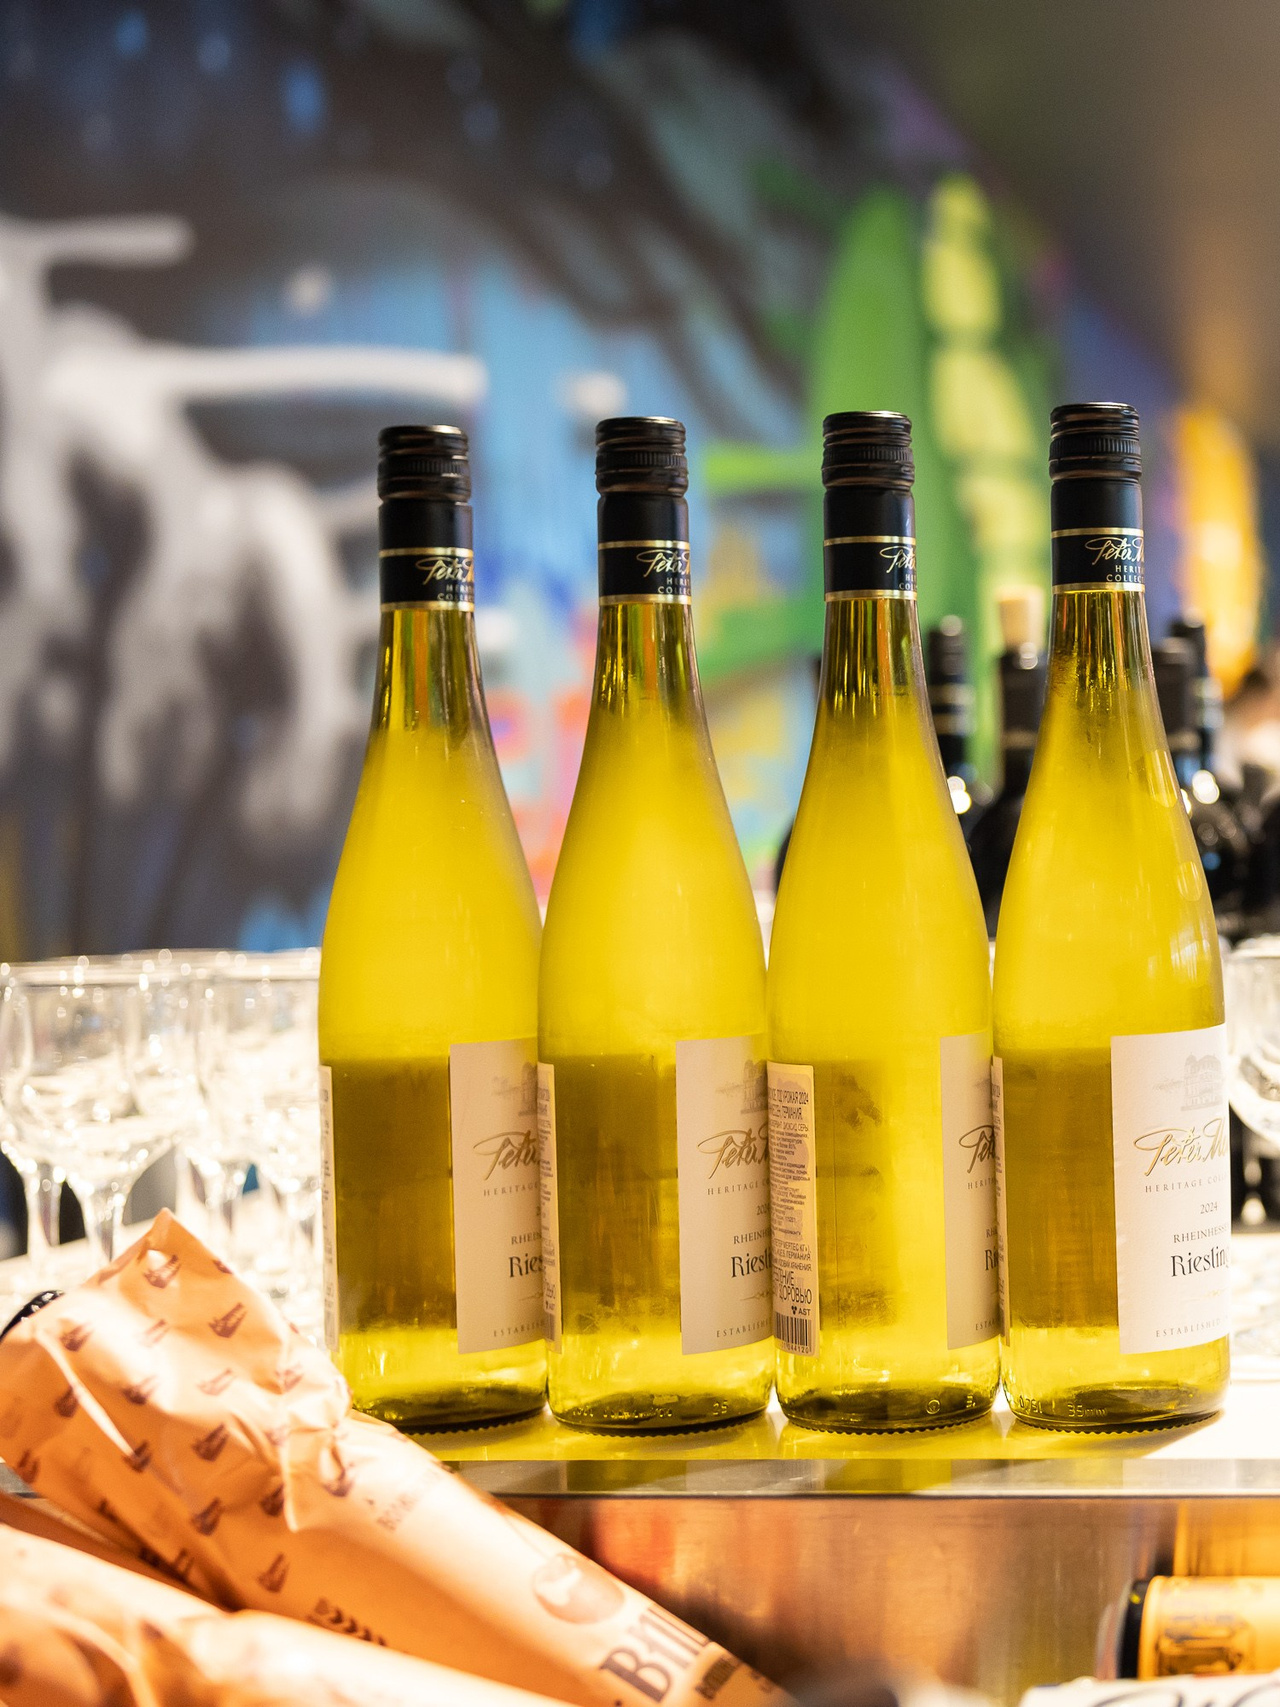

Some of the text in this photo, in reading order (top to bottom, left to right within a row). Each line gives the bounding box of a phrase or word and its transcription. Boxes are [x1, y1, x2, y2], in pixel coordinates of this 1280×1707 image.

[697, 1128, 757, 1179] Peter
[1133, 1126, 1201, 1176] Peter
[707, 1180, 759, 1196] HERITAGE
[1145, 1178, 1202, 1192] HERITAGE
[1200, 1201, 1219, 1214] 2024
[798, 1307, 811, 1316] AST
